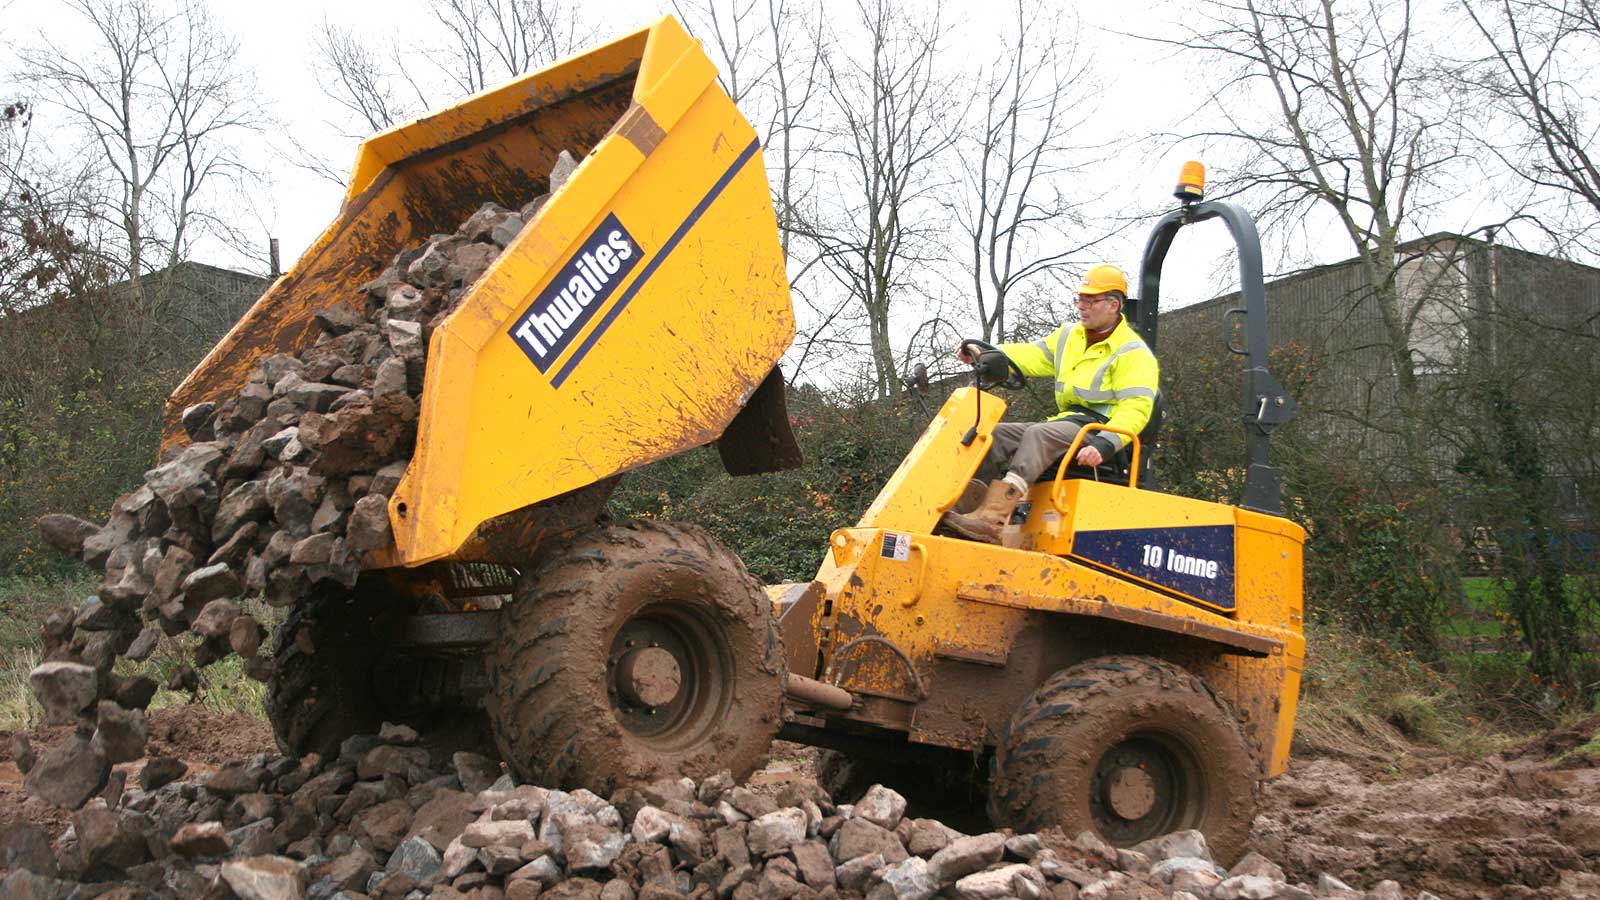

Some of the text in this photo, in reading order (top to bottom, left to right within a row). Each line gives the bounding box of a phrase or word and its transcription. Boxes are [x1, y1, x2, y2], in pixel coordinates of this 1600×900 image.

[515, 230, 632, 358] Thwaites
[1143, 544, 1217, 579] 10 tonne
